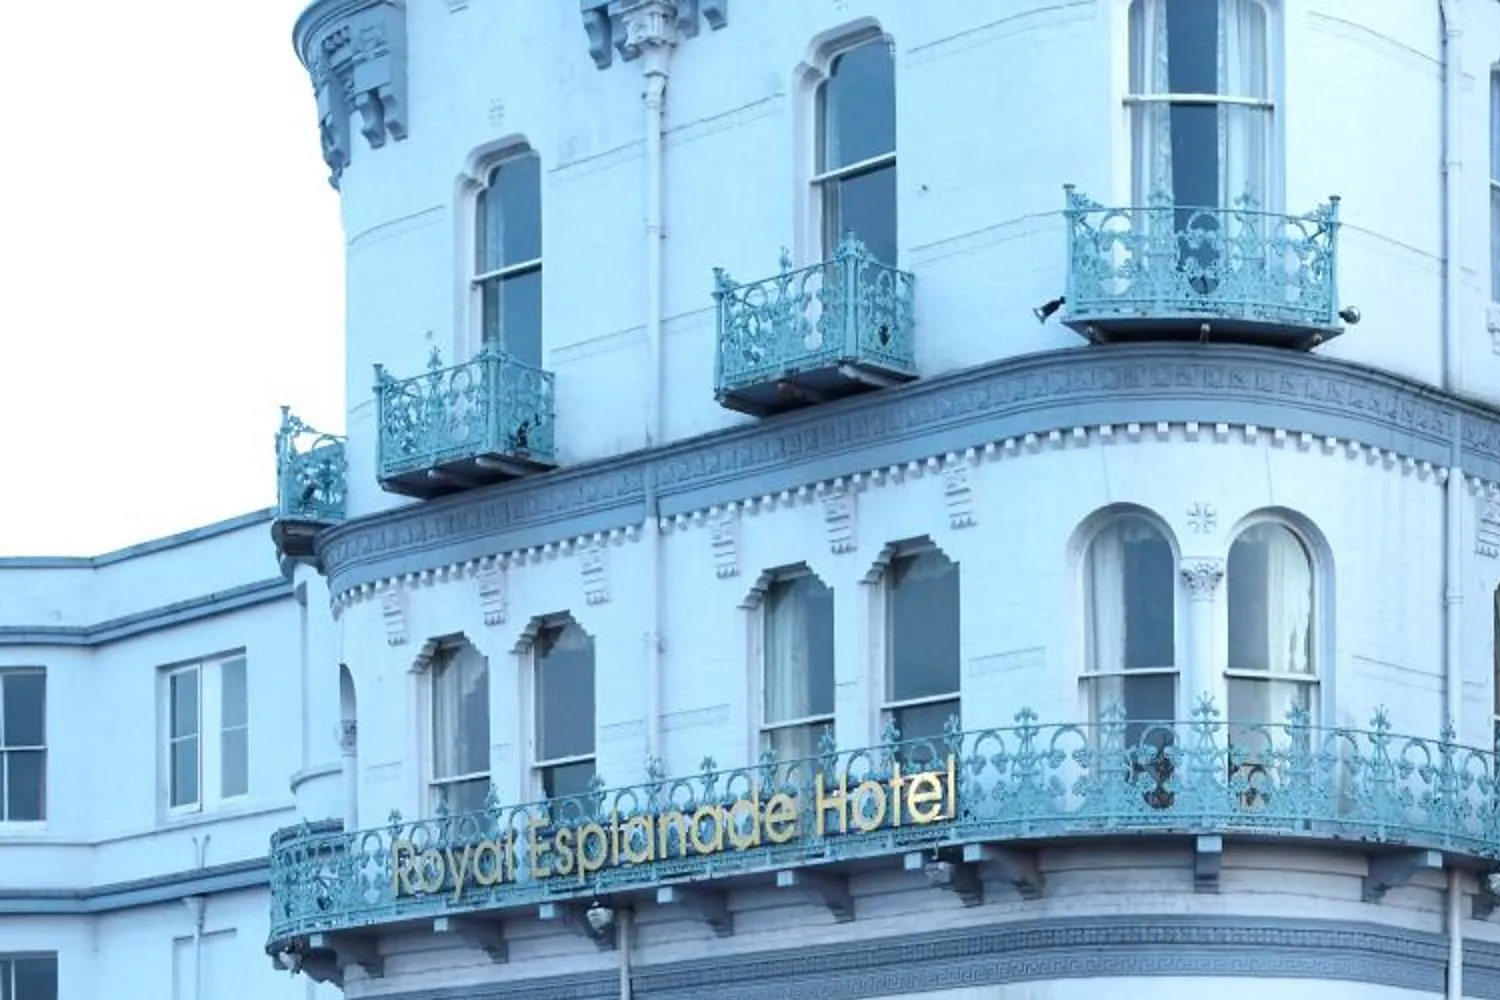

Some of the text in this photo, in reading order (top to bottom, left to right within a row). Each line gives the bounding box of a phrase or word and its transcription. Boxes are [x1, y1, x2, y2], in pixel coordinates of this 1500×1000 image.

[391, 753, 956, 901] Royal Esplanade Hotel
